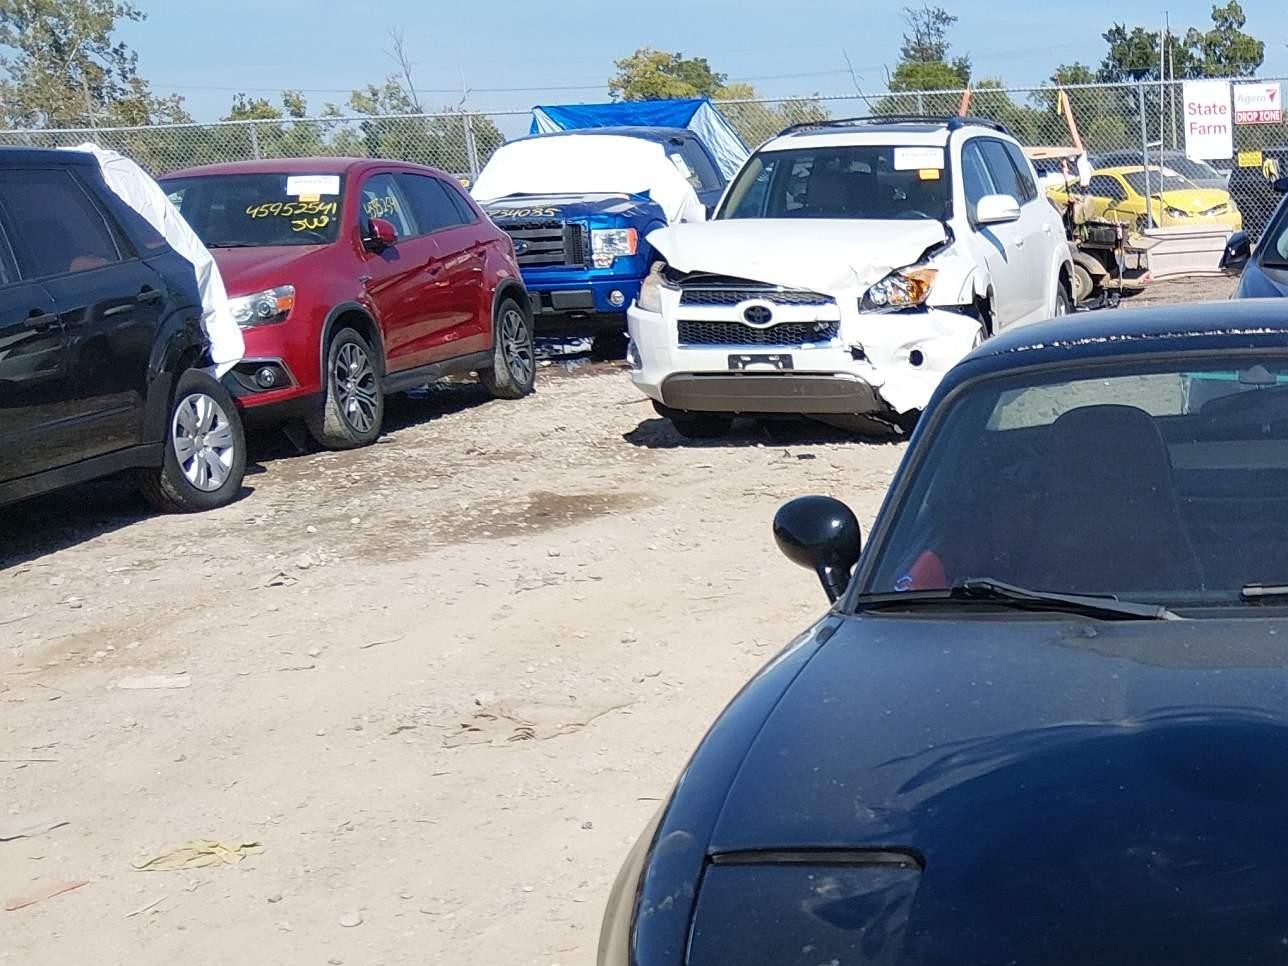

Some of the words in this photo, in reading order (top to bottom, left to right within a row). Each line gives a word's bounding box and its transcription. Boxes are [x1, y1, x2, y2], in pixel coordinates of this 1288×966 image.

[1237, 93, 1266, 104] Agero
[1187, 102, 1228, 116] State
[1237, 111, 1258, 122] DROP
[1259, 110, 1280, 122] ZONE
[1189, 121, 1227, 136] Farm
[246, 202, 337, 219] 45952541
